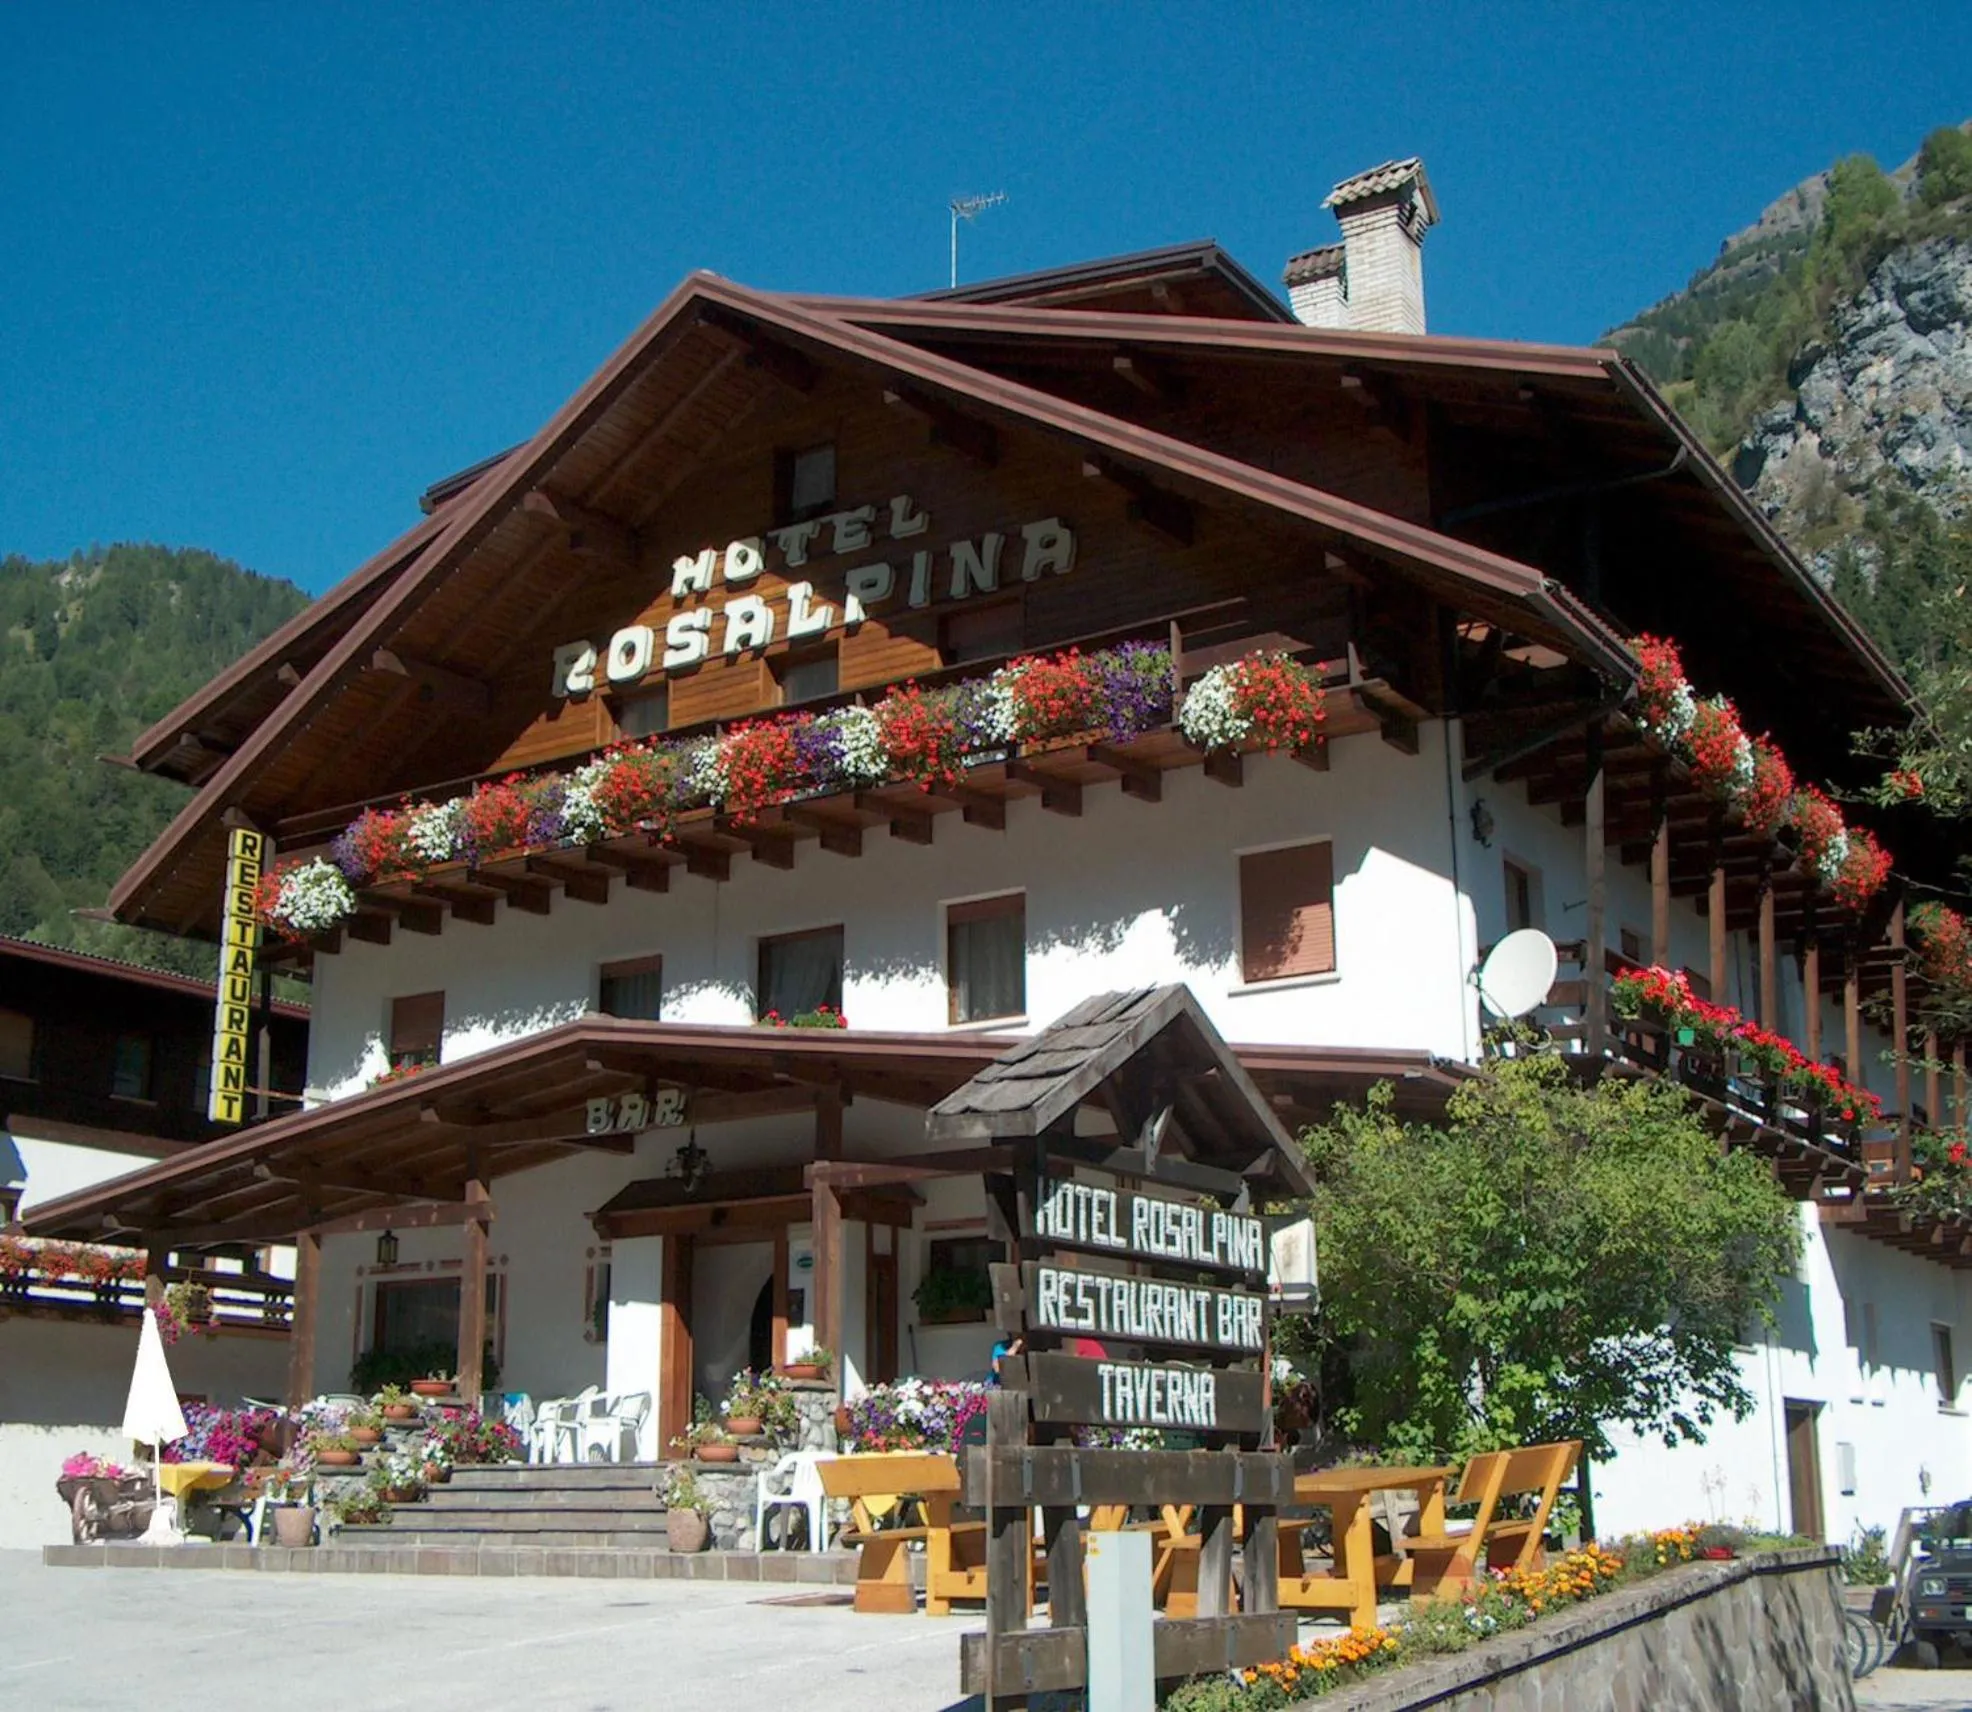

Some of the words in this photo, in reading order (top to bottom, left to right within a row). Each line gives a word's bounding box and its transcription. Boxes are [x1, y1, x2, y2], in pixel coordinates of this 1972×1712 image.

[669, 494, 929, 599] HOTEL
[551, 516, 1078, 699] ROSALPINA
[218, 833, 258, 1120] RESTAURANT
[586, 1088, 686, 1134] BAR
[1036, 1175, 1127, 1249] HOTEL
[1132, 1197, 1264, 1272] ROSALPINA
[1038, 1268, 1212, 1343] RESTAURANT
[1217, 1295, 1264, 1348] BAR
[1098, 1363, 1217, 1427] TAVERNA
